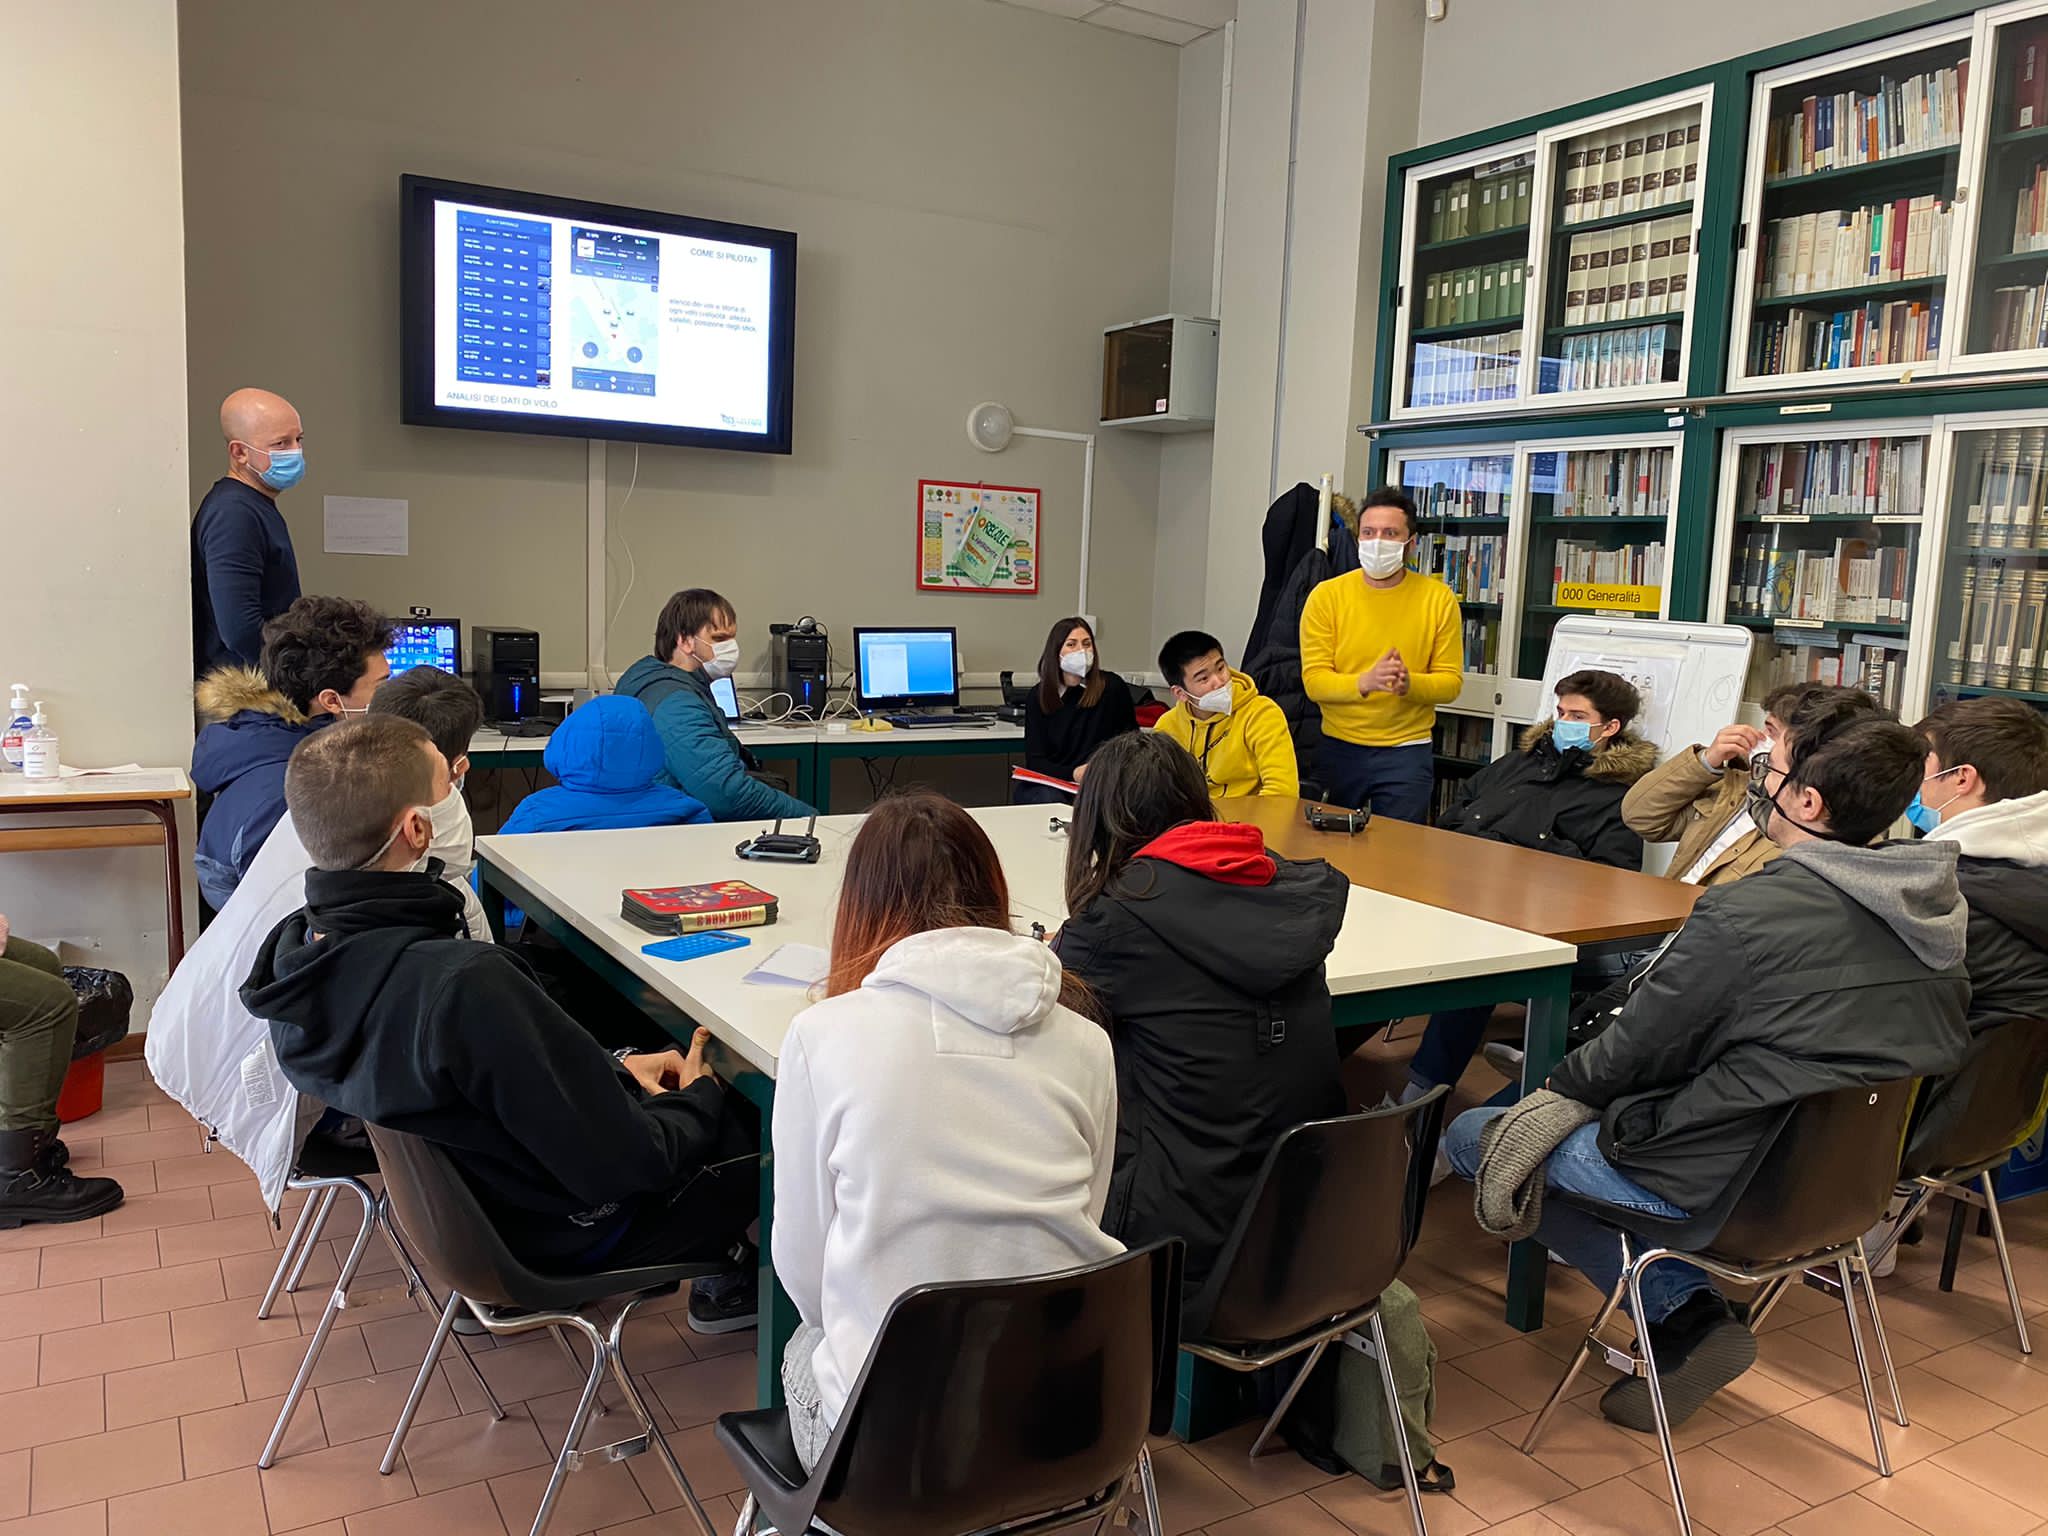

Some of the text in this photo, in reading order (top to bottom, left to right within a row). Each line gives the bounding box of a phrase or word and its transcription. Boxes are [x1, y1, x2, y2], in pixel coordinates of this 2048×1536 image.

[690, 248, 758, 263] COME SI PILOTA?
[446, 391, 558, 408] ANALISI DEI DATI DI VOLO
[1562, 587, 1641, 603] 000 Generalità
[728, 910, 752, 923] IRON
